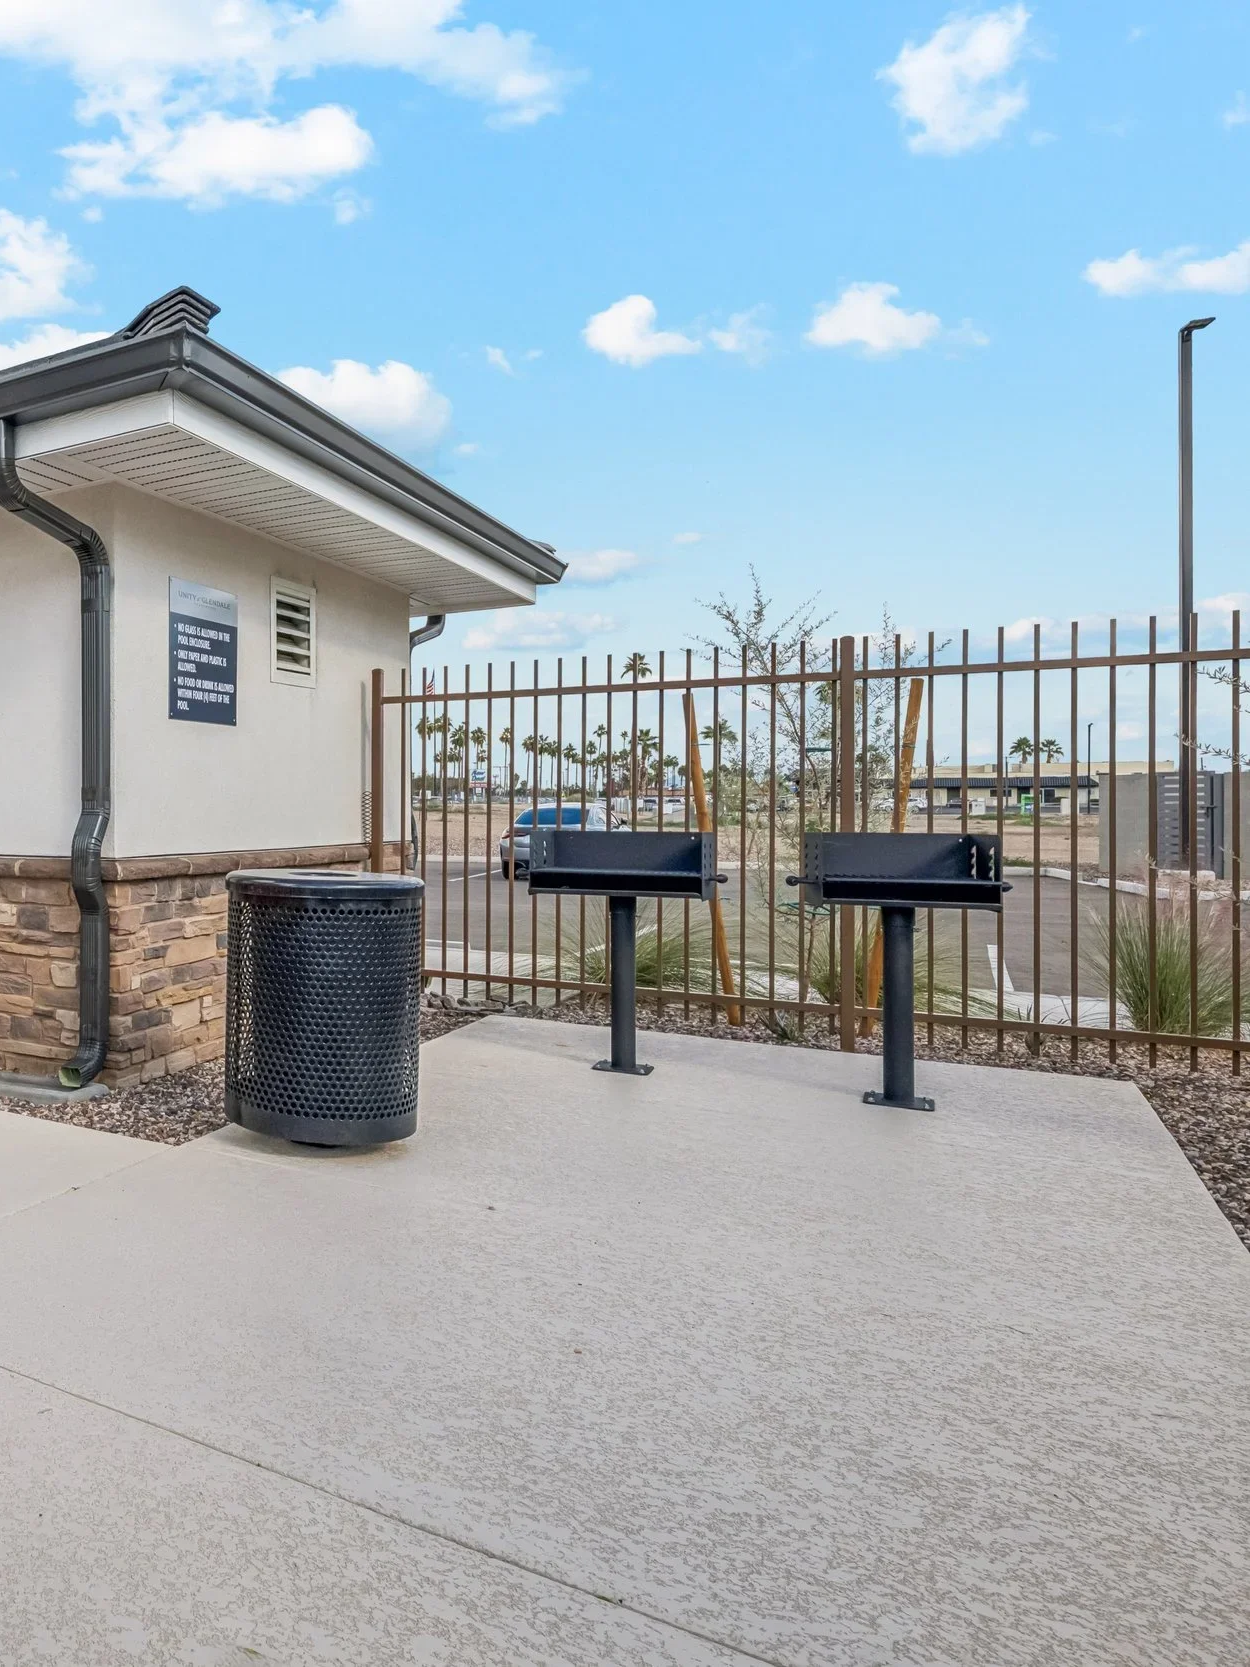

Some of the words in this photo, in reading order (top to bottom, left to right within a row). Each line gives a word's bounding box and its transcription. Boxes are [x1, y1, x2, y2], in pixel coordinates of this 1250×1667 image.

[177, 622, 184, 633] NO
[185, 624, 196, 635] GLASS
[177, 634, 188, 645] POOL
[184, 677, 195, 687] FOOD
